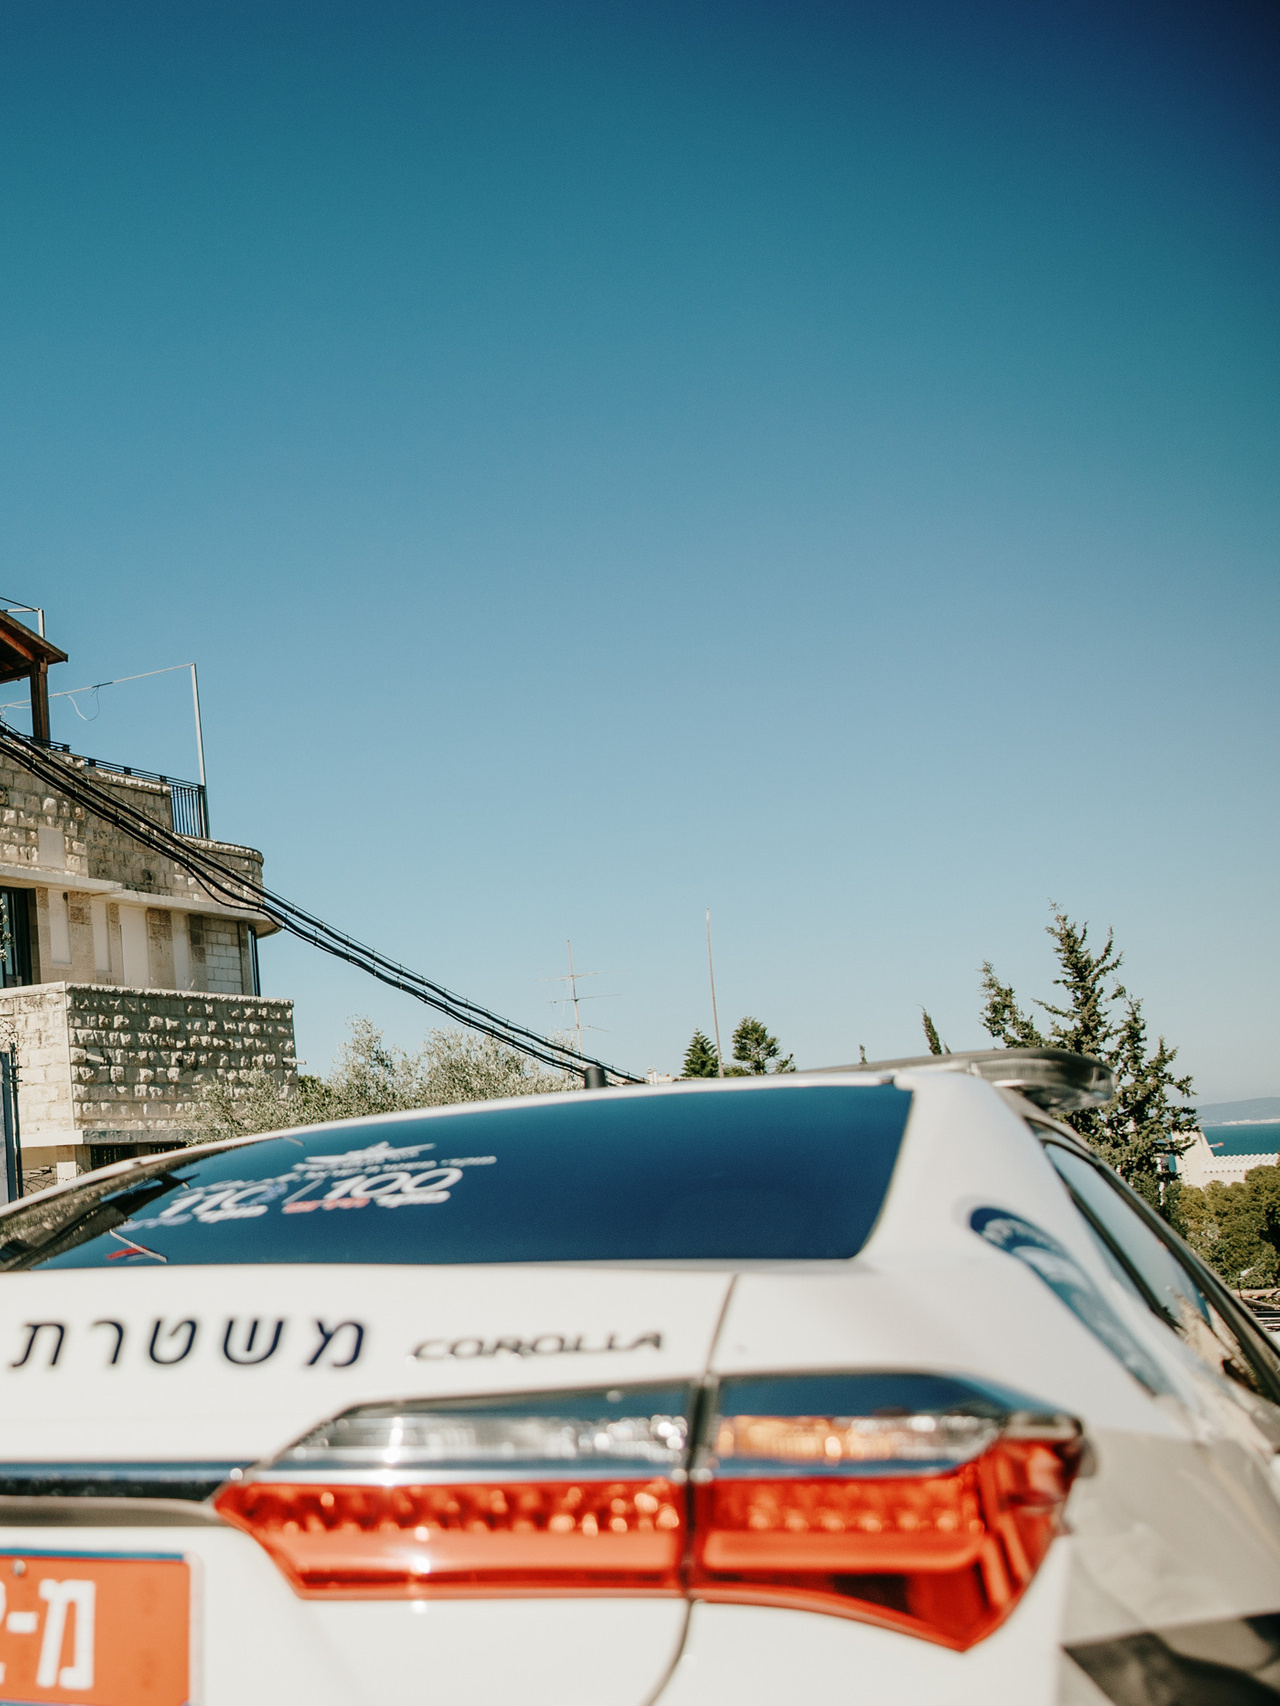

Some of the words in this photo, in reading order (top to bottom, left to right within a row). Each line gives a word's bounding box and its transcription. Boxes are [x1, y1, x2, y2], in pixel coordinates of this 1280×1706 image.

[324, 1168, 463, 1202] 100
[10, 1319, 365, 1368] משטרת
[408, 1330, 663, 1362] COROLLA
